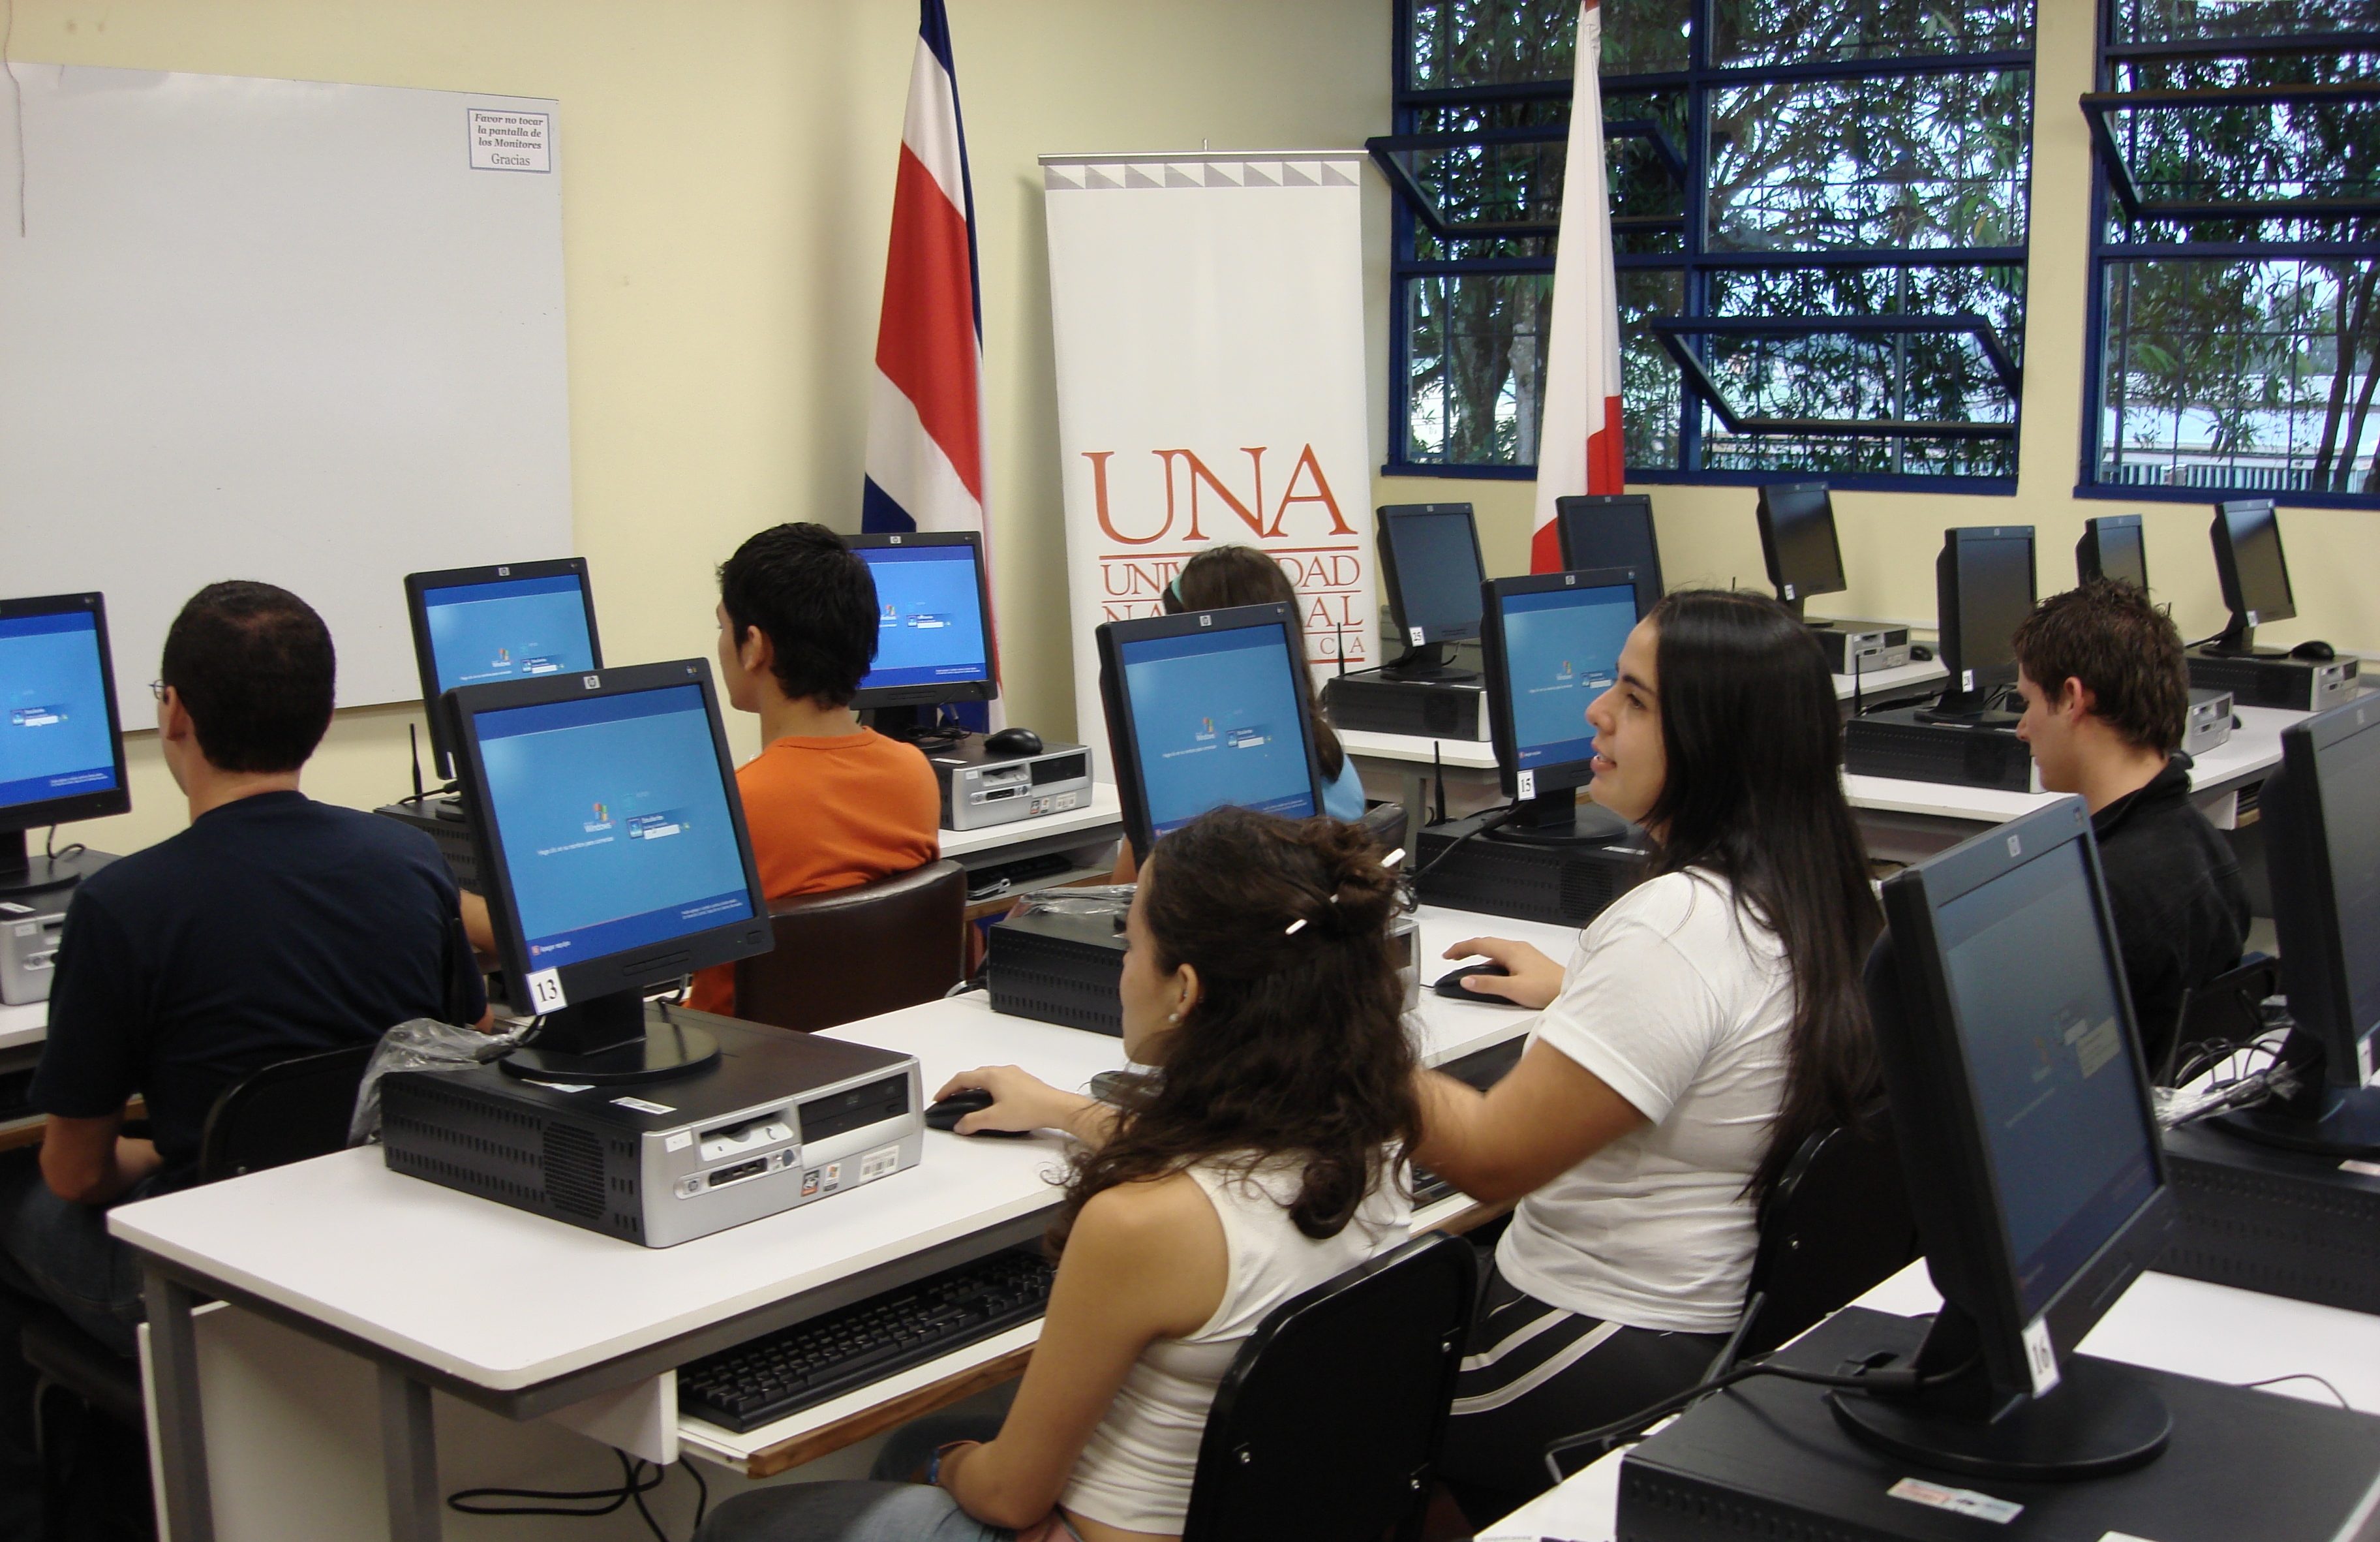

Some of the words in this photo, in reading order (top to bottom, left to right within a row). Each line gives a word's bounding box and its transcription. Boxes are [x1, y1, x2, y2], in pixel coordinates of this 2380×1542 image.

[475, 114, 503, 123] Favor
[519, 117, 543, 126] tocar
[478, 125, 487, 134] la
[489, 127, 528, 136] pantalla
[530, 129, 542, 137] de
[478, 137, 492, 146] los
[494, 138, 542, 149] Monitores
[491, 153, 530, 166] Gracias
[1081, 443, 1358, 546] UNA
[1521, 778, 1531, 793] 15
[536, 979, 557, 1003] 13
[2032, 1336, 2050, 1375] 16
